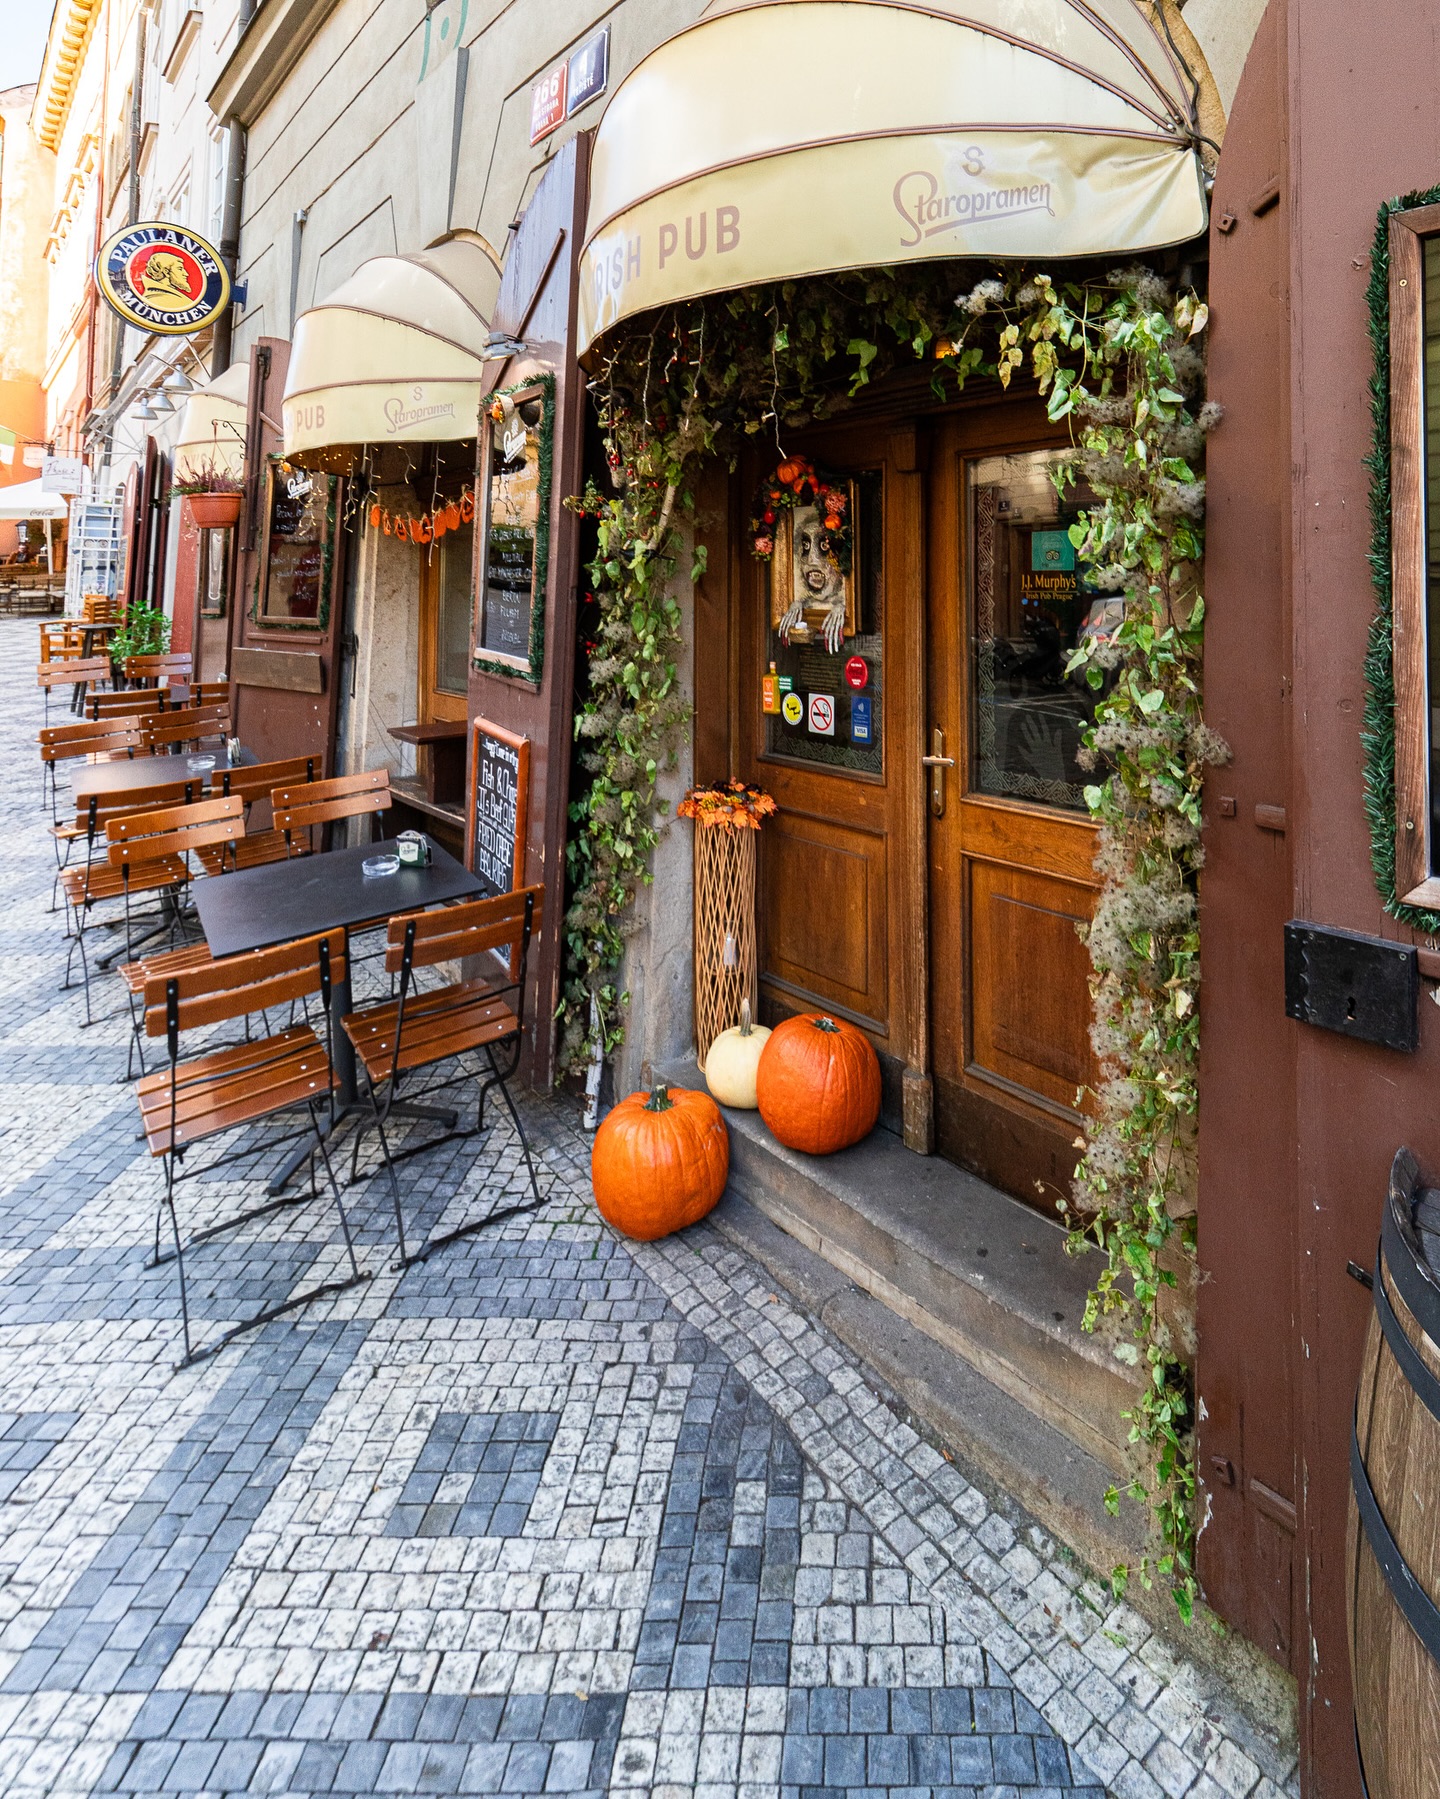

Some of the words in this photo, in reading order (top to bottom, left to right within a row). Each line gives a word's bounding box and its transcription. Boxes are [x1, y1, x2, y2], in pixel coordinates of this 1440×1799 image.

[534, 71, 560, 109] 266
[892, 170, 1055, 247] Staropramen
[110, 228, 219, 277] PAULANER
[658, 205, 741, 270] PUB
[119, 290, 213, 325] MÜNCHEN
[296, 404, 325, 433] PUB
[384, 397, 456, 434] Staropramen
[1021, 574, 1033, 591] J.J.
[1035, 573, 1077, 592] Murphy's
[1025, 592, 1039, 600] Irish
[1040, 592, 1051, 600] Pub
[1052, 592, 1073, 602] Prague
[482, 759, 495, 790] Fish
[496, 766, 503, 794] &
[490, 792, 503, 823] Beef
